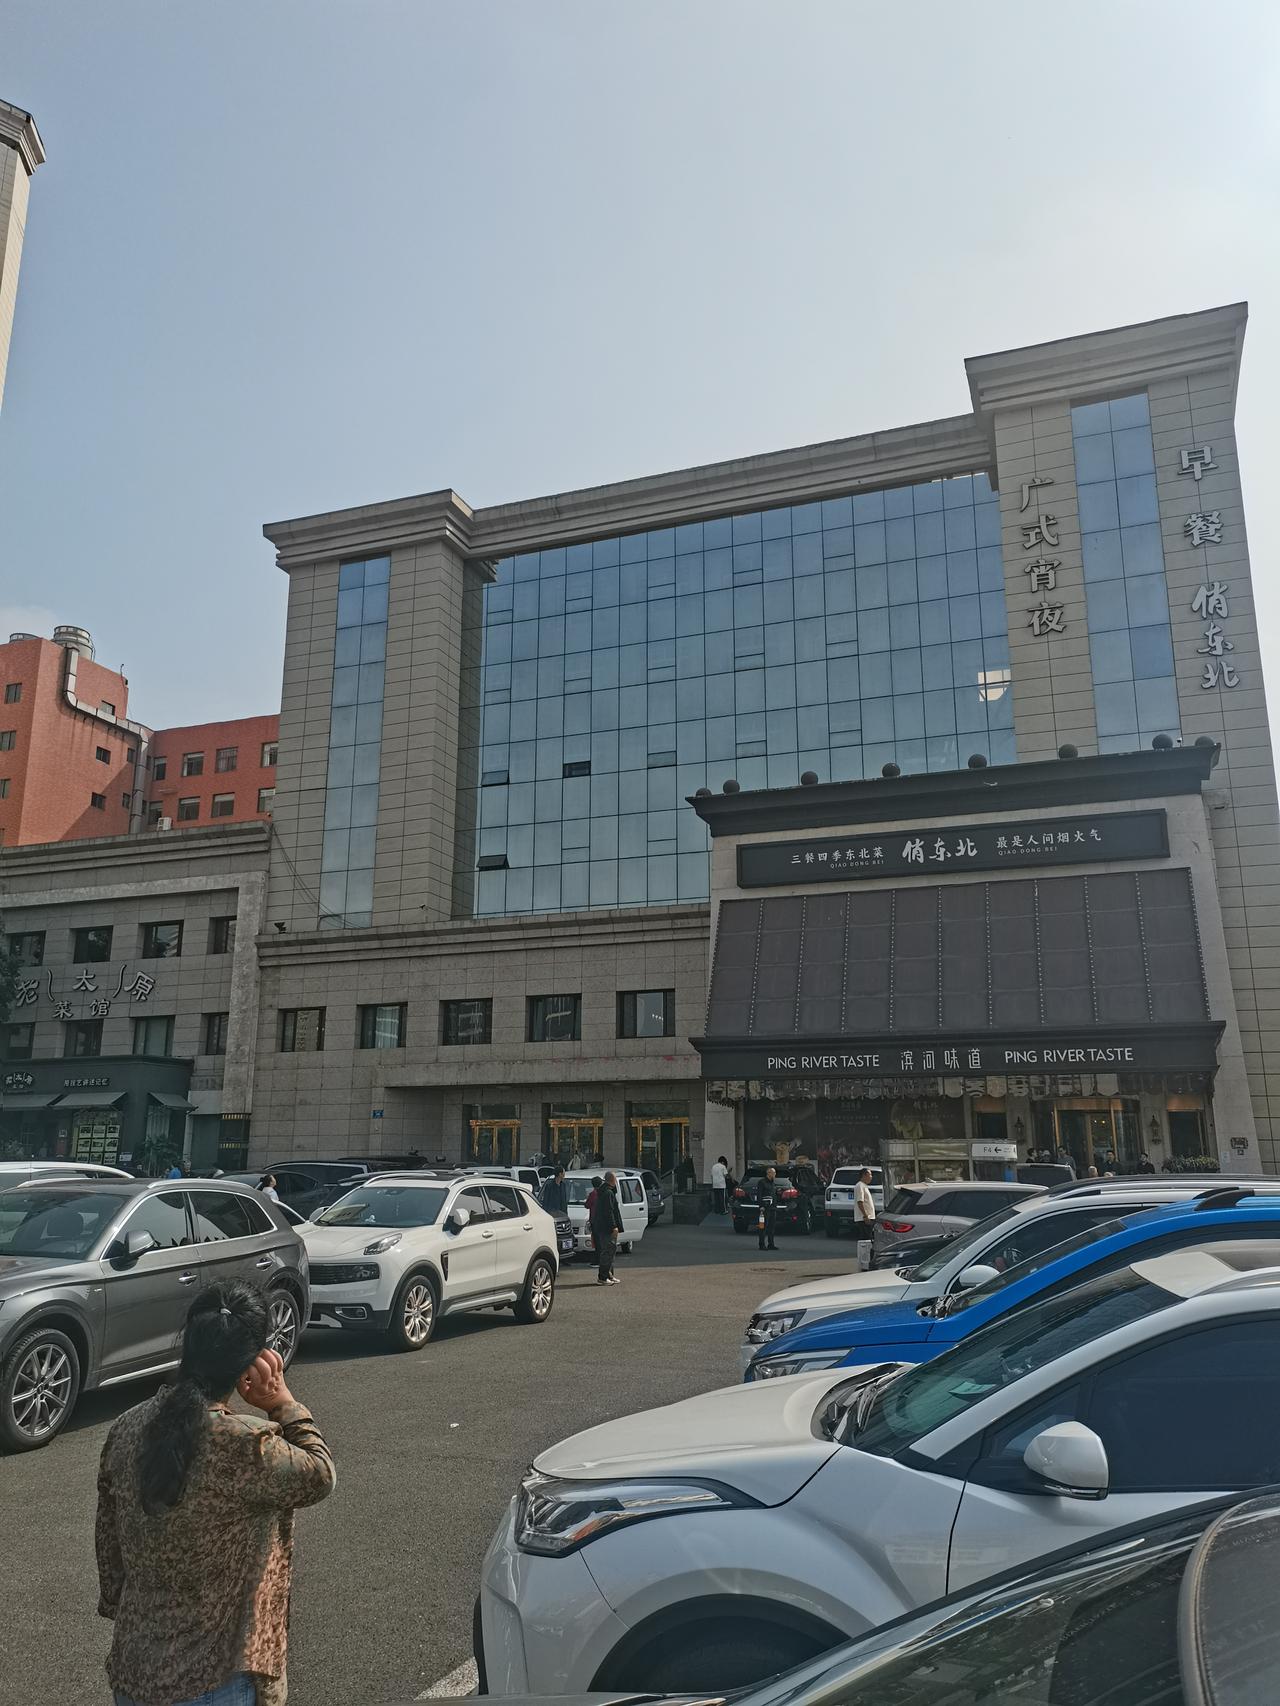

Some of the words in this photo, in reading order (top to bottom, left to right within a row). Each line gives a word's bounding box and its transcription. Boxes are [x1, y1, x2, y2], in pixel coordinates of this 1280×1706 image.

[1178, 445, 1224, 546] 早餐
[1020, 477, 1067, 637] 广式宵夜
[1192, 581, 1240, 690] 俏东北
[997, 828, 1102, 849] 最是人间烟火气
[791, 846, 884, 864] 三餐四季东北菜
[902, 837, 978, 864] 俏东北
[53, 998, 111, 1019] 菜馆
[767, 1057, 797, 1069] PING
[801, 1055, 838, 1069] RIVER
[840, 1054, 880, 1067] TASTE
[1005, 1050, 1038, 1063] PING
[1043, 1049, 1086, 1062] RIVER
[1086, 1047, 1134, 1061] TASTE
